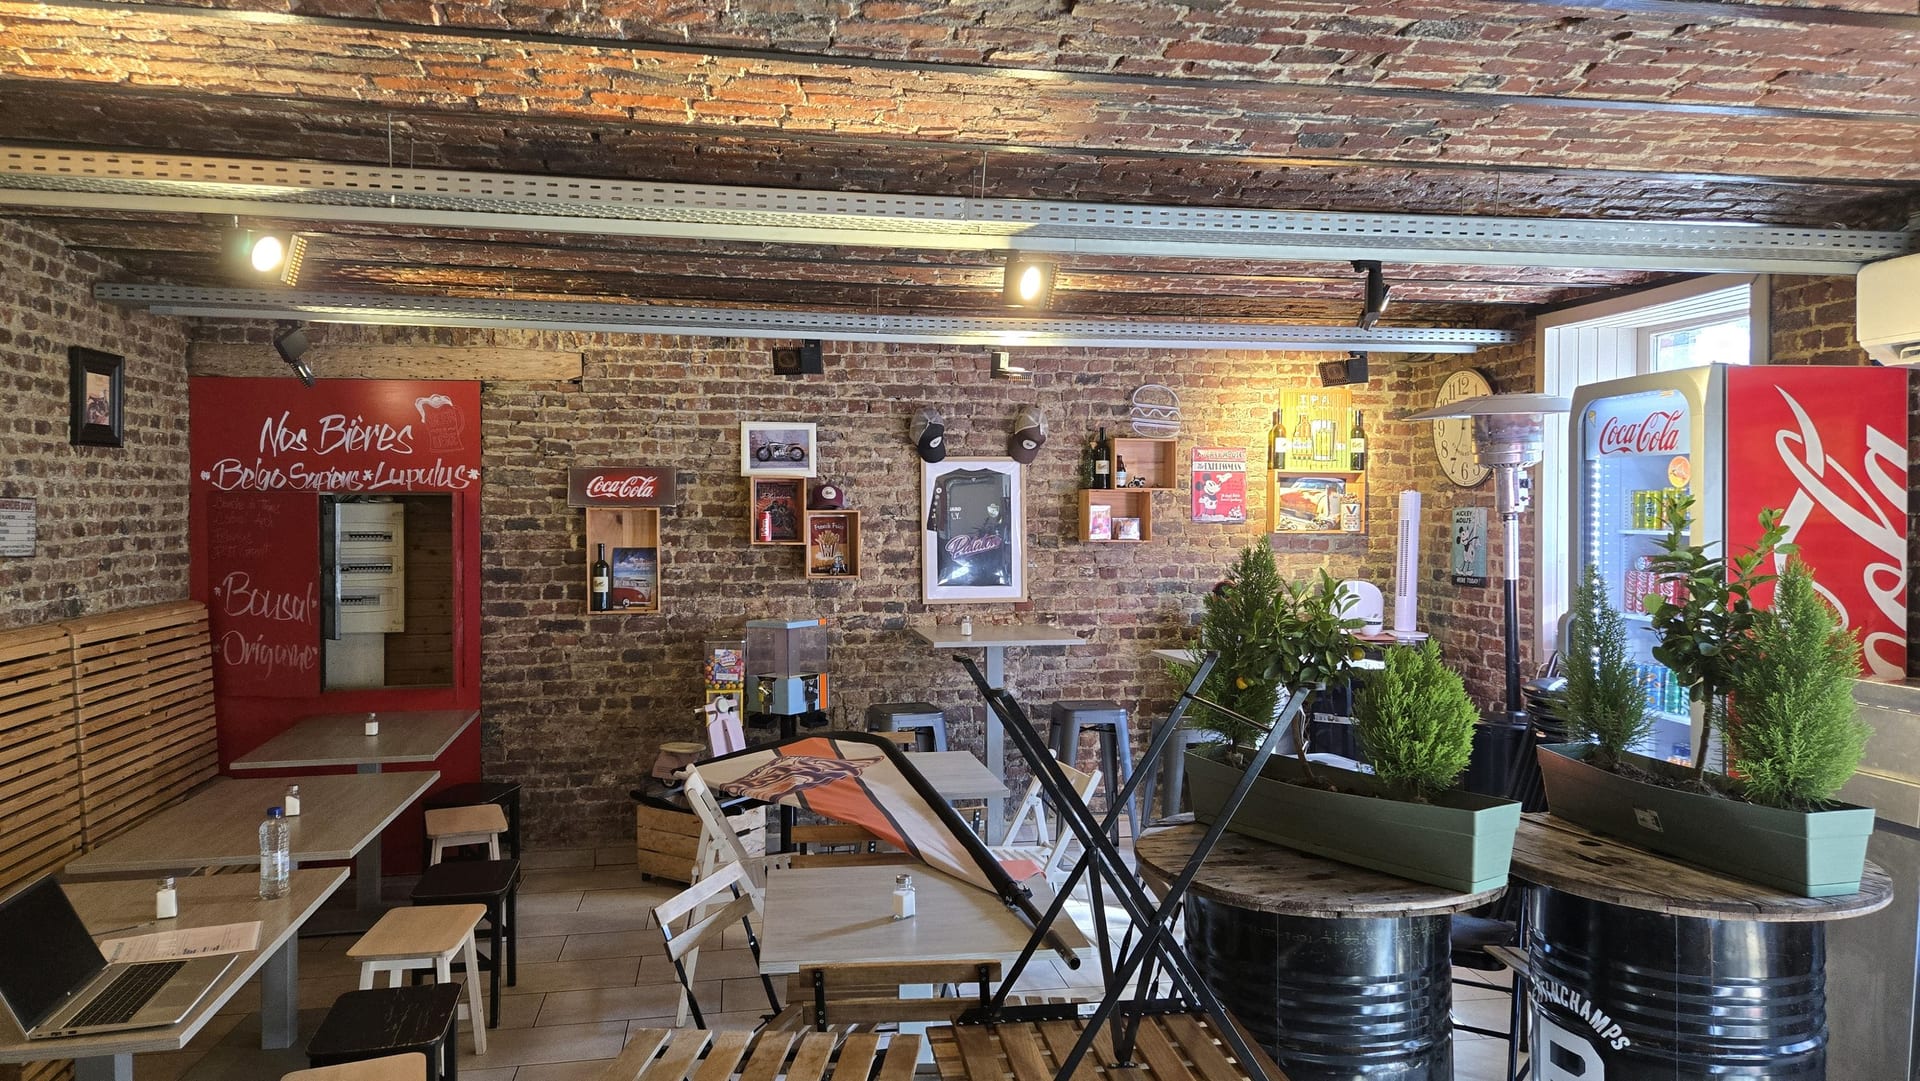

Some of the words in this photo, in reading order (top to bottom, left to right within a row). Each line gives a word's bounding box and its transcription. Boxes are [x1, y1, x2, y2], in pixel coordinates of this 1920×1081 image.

[259, 410, 309, 457] Nos
[313, 414, 414, 455] Bières
[1599, 410, 1684, 455] Coca-Cola
[1441, 440, 1449, 458] 8
[212, 458, 287, 491] Belgo
[368, 458, 471, 491] Lupulus
[1461, 462, 1468, 480] 6
[586, 475, 658, 498] Coca-Cola
